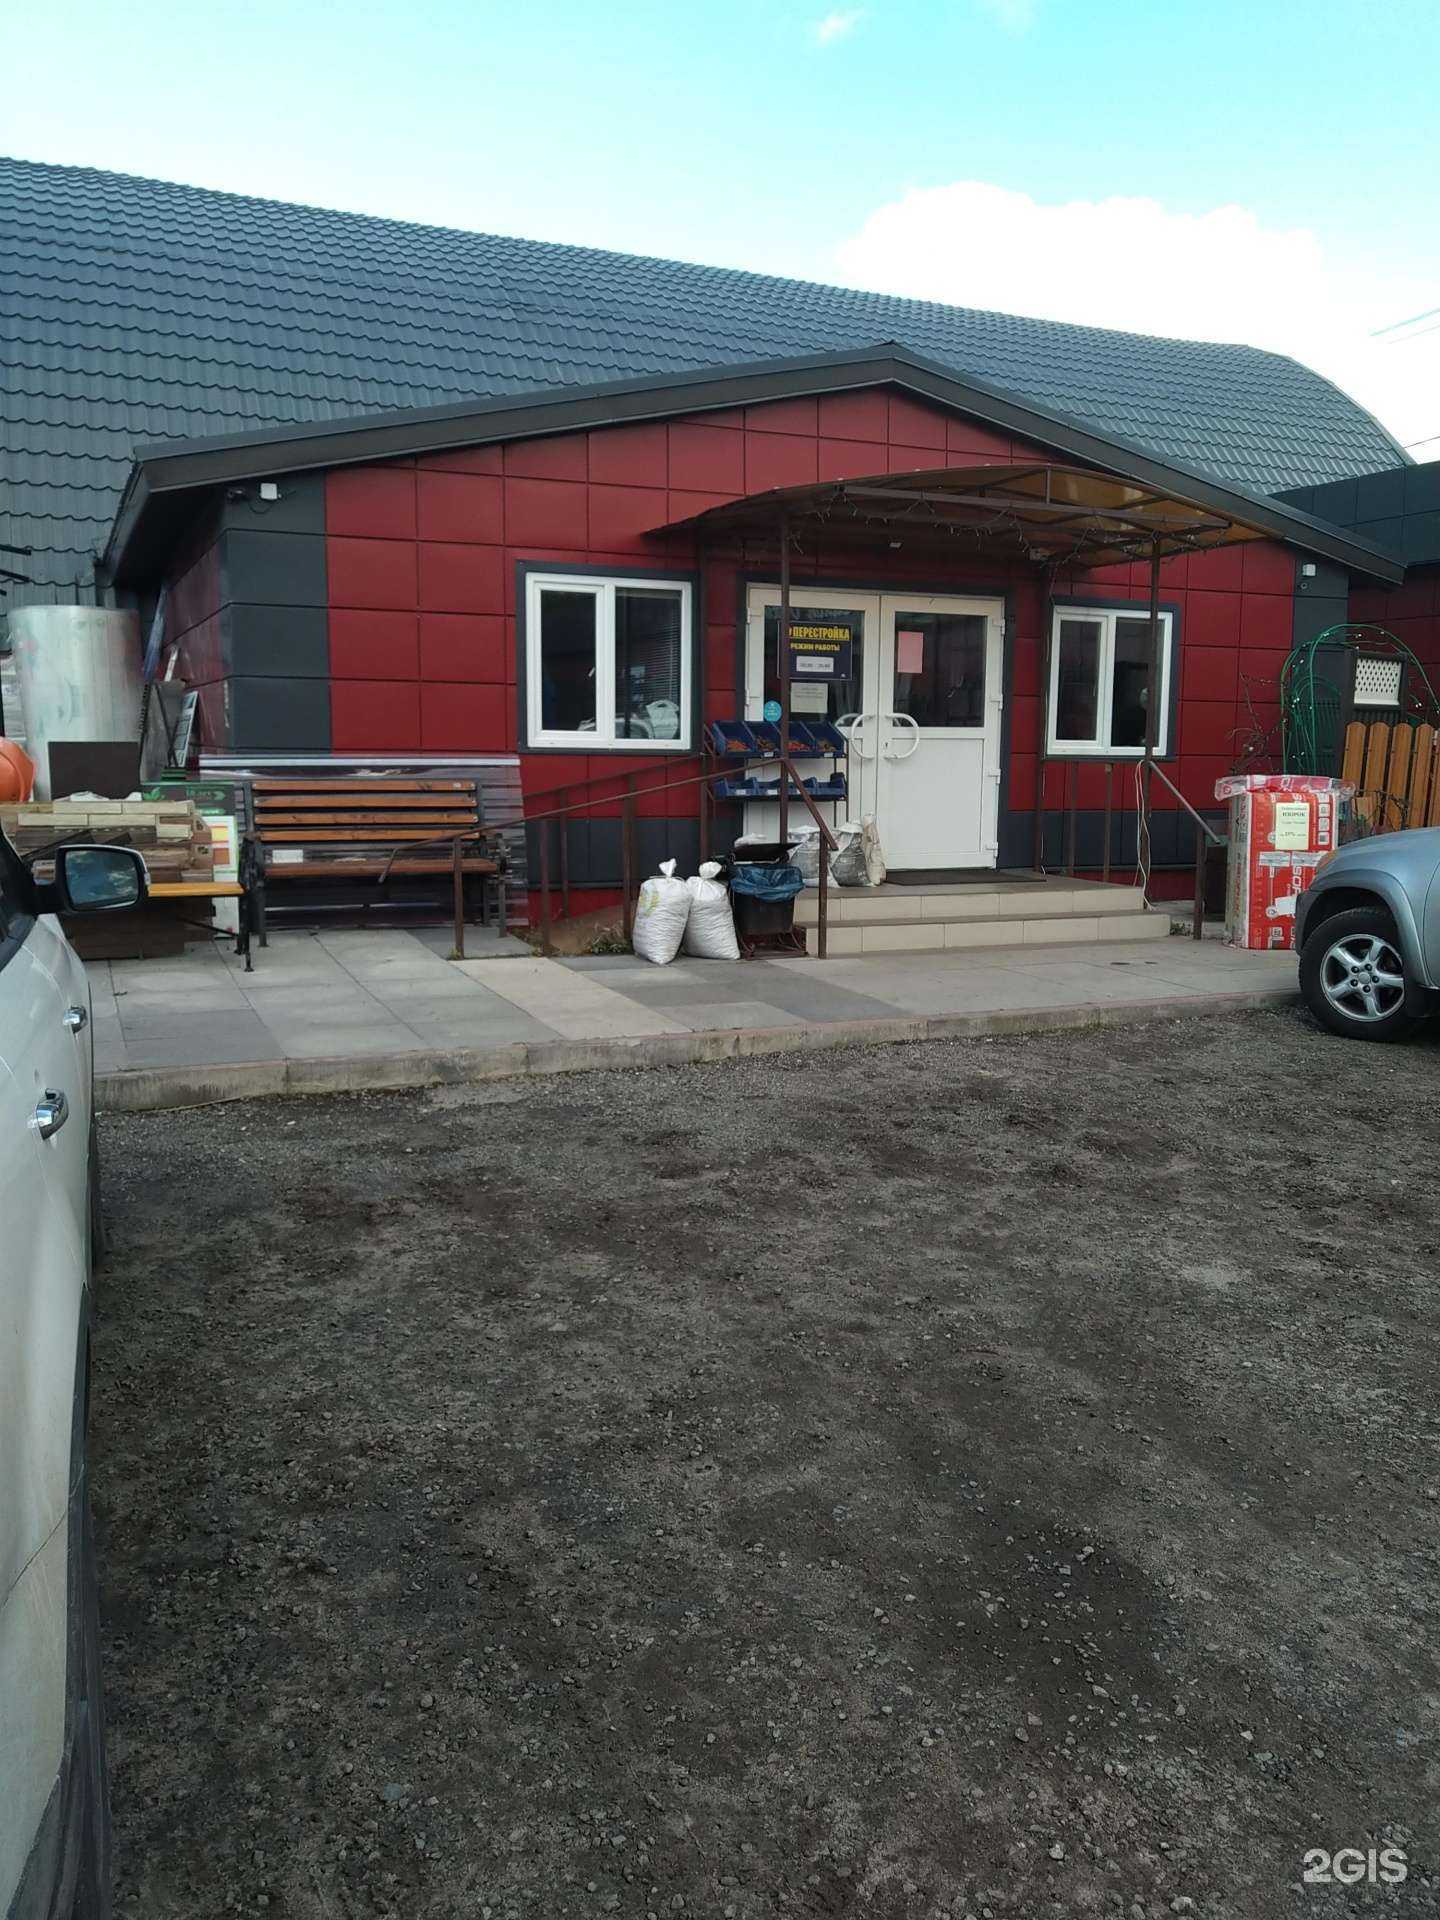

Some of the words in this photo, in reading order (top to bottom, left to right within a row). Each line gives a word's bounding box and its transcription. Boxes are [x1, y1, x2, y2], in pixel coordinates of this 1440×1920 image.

[793, 626, 850, 640] ПЕРЕСТРОЙКА
[791, 642, 814, 650] РЕЖИМ
[815, 643, 840, 651] РАБОТЫ
